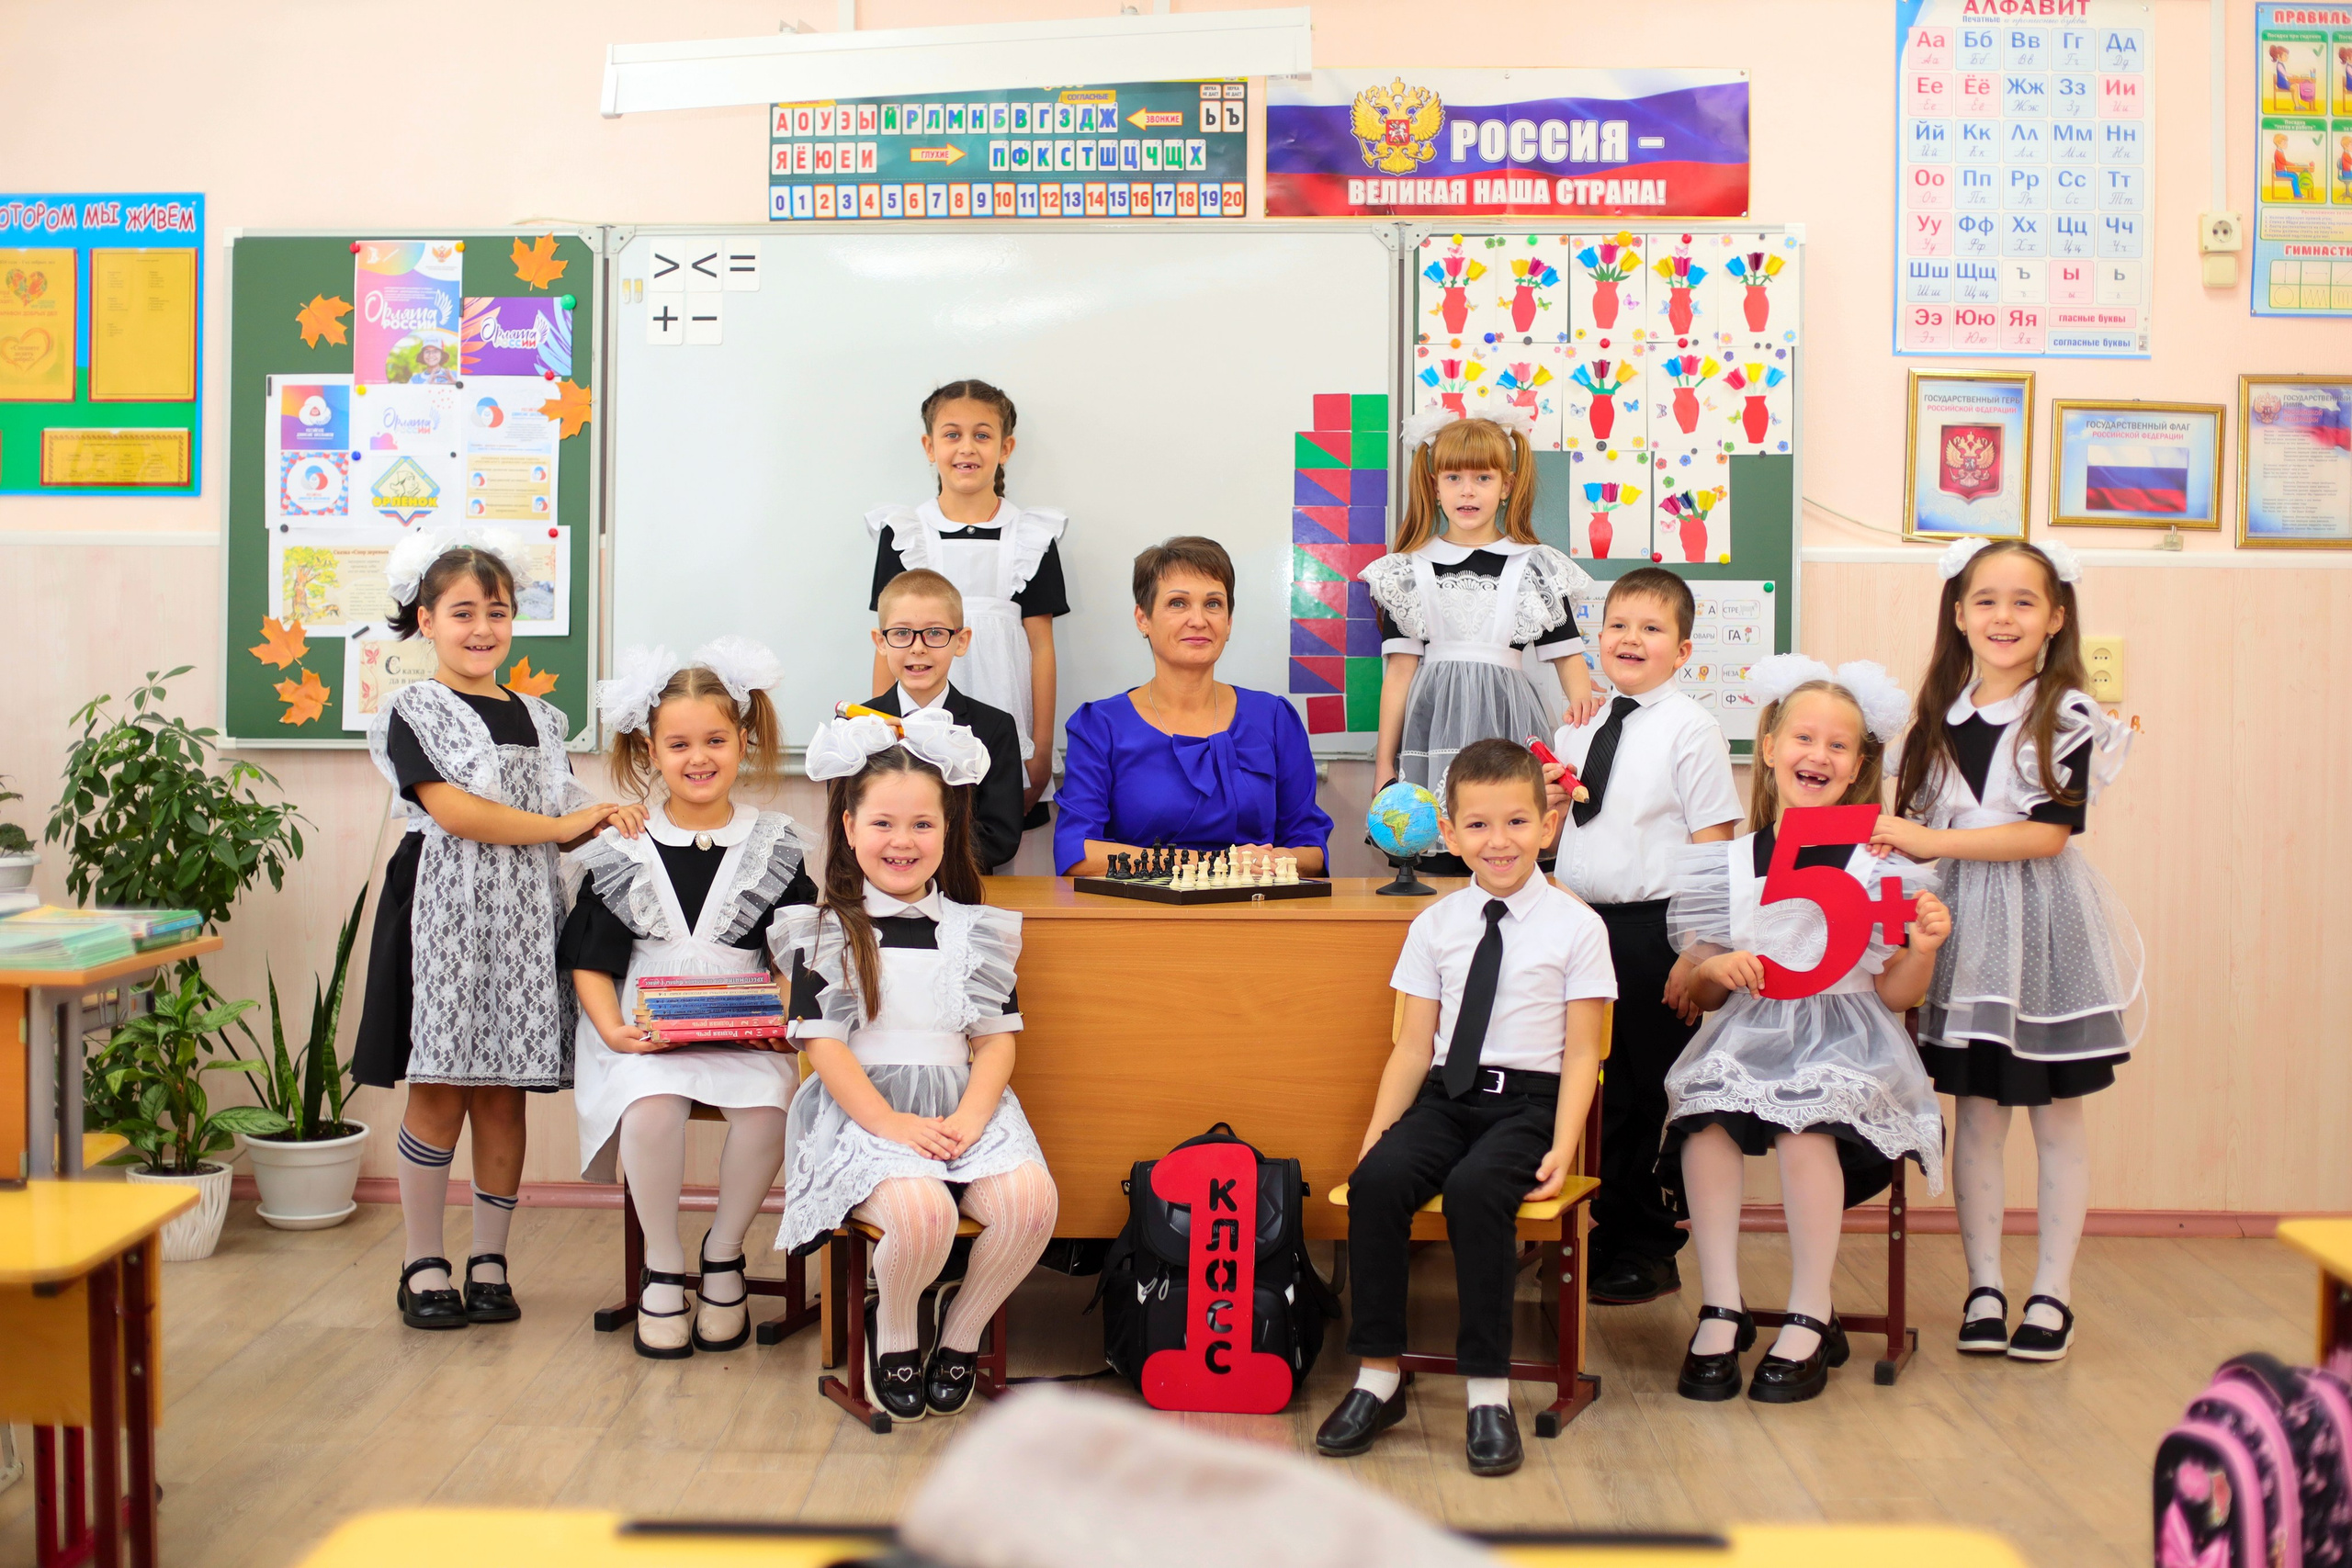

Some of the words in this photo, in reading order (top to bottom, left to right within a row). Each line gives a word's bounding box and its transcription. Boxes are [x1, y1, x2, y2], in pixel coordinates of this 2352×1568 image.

[1963, 0, 2090, 16] АЛФАВИТ
[776, 113, 788, 131] А
[798, 112, 808, 130] О
[820, 112, 831, 130] У
[842, 111, 850, 130] Э
[859, 111, 875, 130] Ы
[885, 107, 896, 130] Й
[908, 110, 918, 130] Р
[927, 110, 940, 129] Л
[949, 110, 962, 129] М
[972, 110, 983, 129] Н
[994, 109, 1005, 128] Б
[1015, 109, 1026, 128] В
[1040, 109, 1049, 128] Г
[1059, 108, 1070, 128] З
[1080, 108, 1093, 130] Д
[1100, 108, 1116, 128] Ж
[1147, 115, 1180, 123] ЗВОНКИЕ
[1206, 108, 1216, 125] Ь
[1227, 108, 1239, 125] Ъ
[1451, 119, 1629, 164] РОССИЯ
[776, 152, 786, 169] Я
[797, 146, 805, 168] Ё
[816, 151, 831, 168] Ю
[842, 150, 850, 168] Е
[862, 150, 872, 168] И
[994, 148, 1004, 166] П
[1012, 148, 1029, 166] Ф
[1038, 148, 1049, 166] К
[1061, 147, 1070, 166] С
[1082, 147, 1093, 166] Т
[1101, 147, 1116, 165] Ш
[1125, 147, 1137, 168] Ц
[1147, 147, 1157, 165] Ч
[1166, 146, 1182, 168] Щ
[1191, 146, 1202, 165] Х
[1348, 178, 1465, 206] ВЕЛИКАЯ
[1474, 178, 1550, 205] НАША
[1555, 178, 1667, 206] СТРАНА!
[776, 195, 785, 209] 0
[799, 195, 804, 209] 1
[820, 194, 829, 209] 2
[842, 194, 852, 209] 3
[865, 194, 874, 209] 4
[888, 193, 896, 209] 5
[910, 193, 919, 209] 6
[933, 193, 941, 208] 7
[955, 193, 963, 208] 8
[978, 192, 986, 208] 9
[996, 192, 1011, 208] 10
[1021, 192, 1035, 207] 11
[1043, 192, 1058, 207] 12
[1065, 192, 1080, 207] 13
[1088, 191, 1103, 207] 14
[1110, 191, 1126, 207] 15
[1133, 191, 1149, 207] 16
[1156, 191, 1172, 207] 17
[1179, 191, 1194, 207] 18
[1202, 191, 1218, 206] 19
[1224, 191, 1242, 207] 20
[85, 204, 119, 227] МЫ
[127, 205, 194, 231] ЖИВЕМ
[2098, 314, 2125, 323] буквы
[2103, 338, 2130, 347] буквы
[1924, 395, 1999, 404] ГОСУДАРСТВЕННЫЙ
[2002, 396, 2020, 404] ГЕРБ
[2086, 421, 2167, 431] ГОСУДАРСТВЕННЫЙ
[2169, 423, 2190, 431] ФЛАГ
[2093, 431, 2139, 439] РОССИЙСКОЙ
[1728, 629, 1741, 640] ГА
[1725, 694, 1736, 705] Ф
[709, 1020, 734, 1028] Родная
[713, 1029, 739, 1037] Родная
